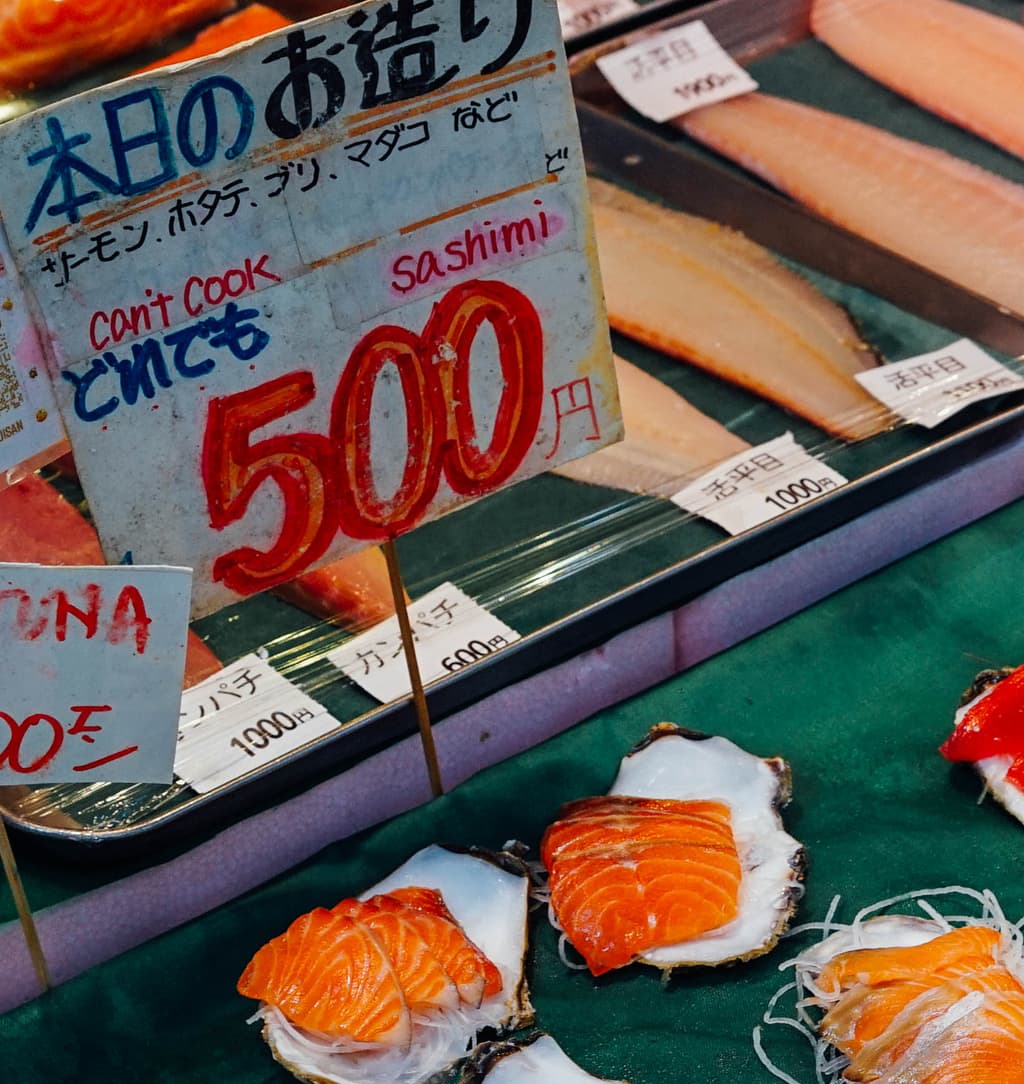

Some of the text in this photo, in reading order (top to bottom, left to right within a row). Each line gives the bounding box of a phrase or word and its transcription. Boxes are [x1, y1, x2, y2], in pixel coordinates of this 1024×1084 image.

[62, 302, 270, 422] どれでも
[765, 477, 837, 511] 1000円
[178, 669, 262, 742] ンパチ
[230, 707, 315, 757] 1000円
